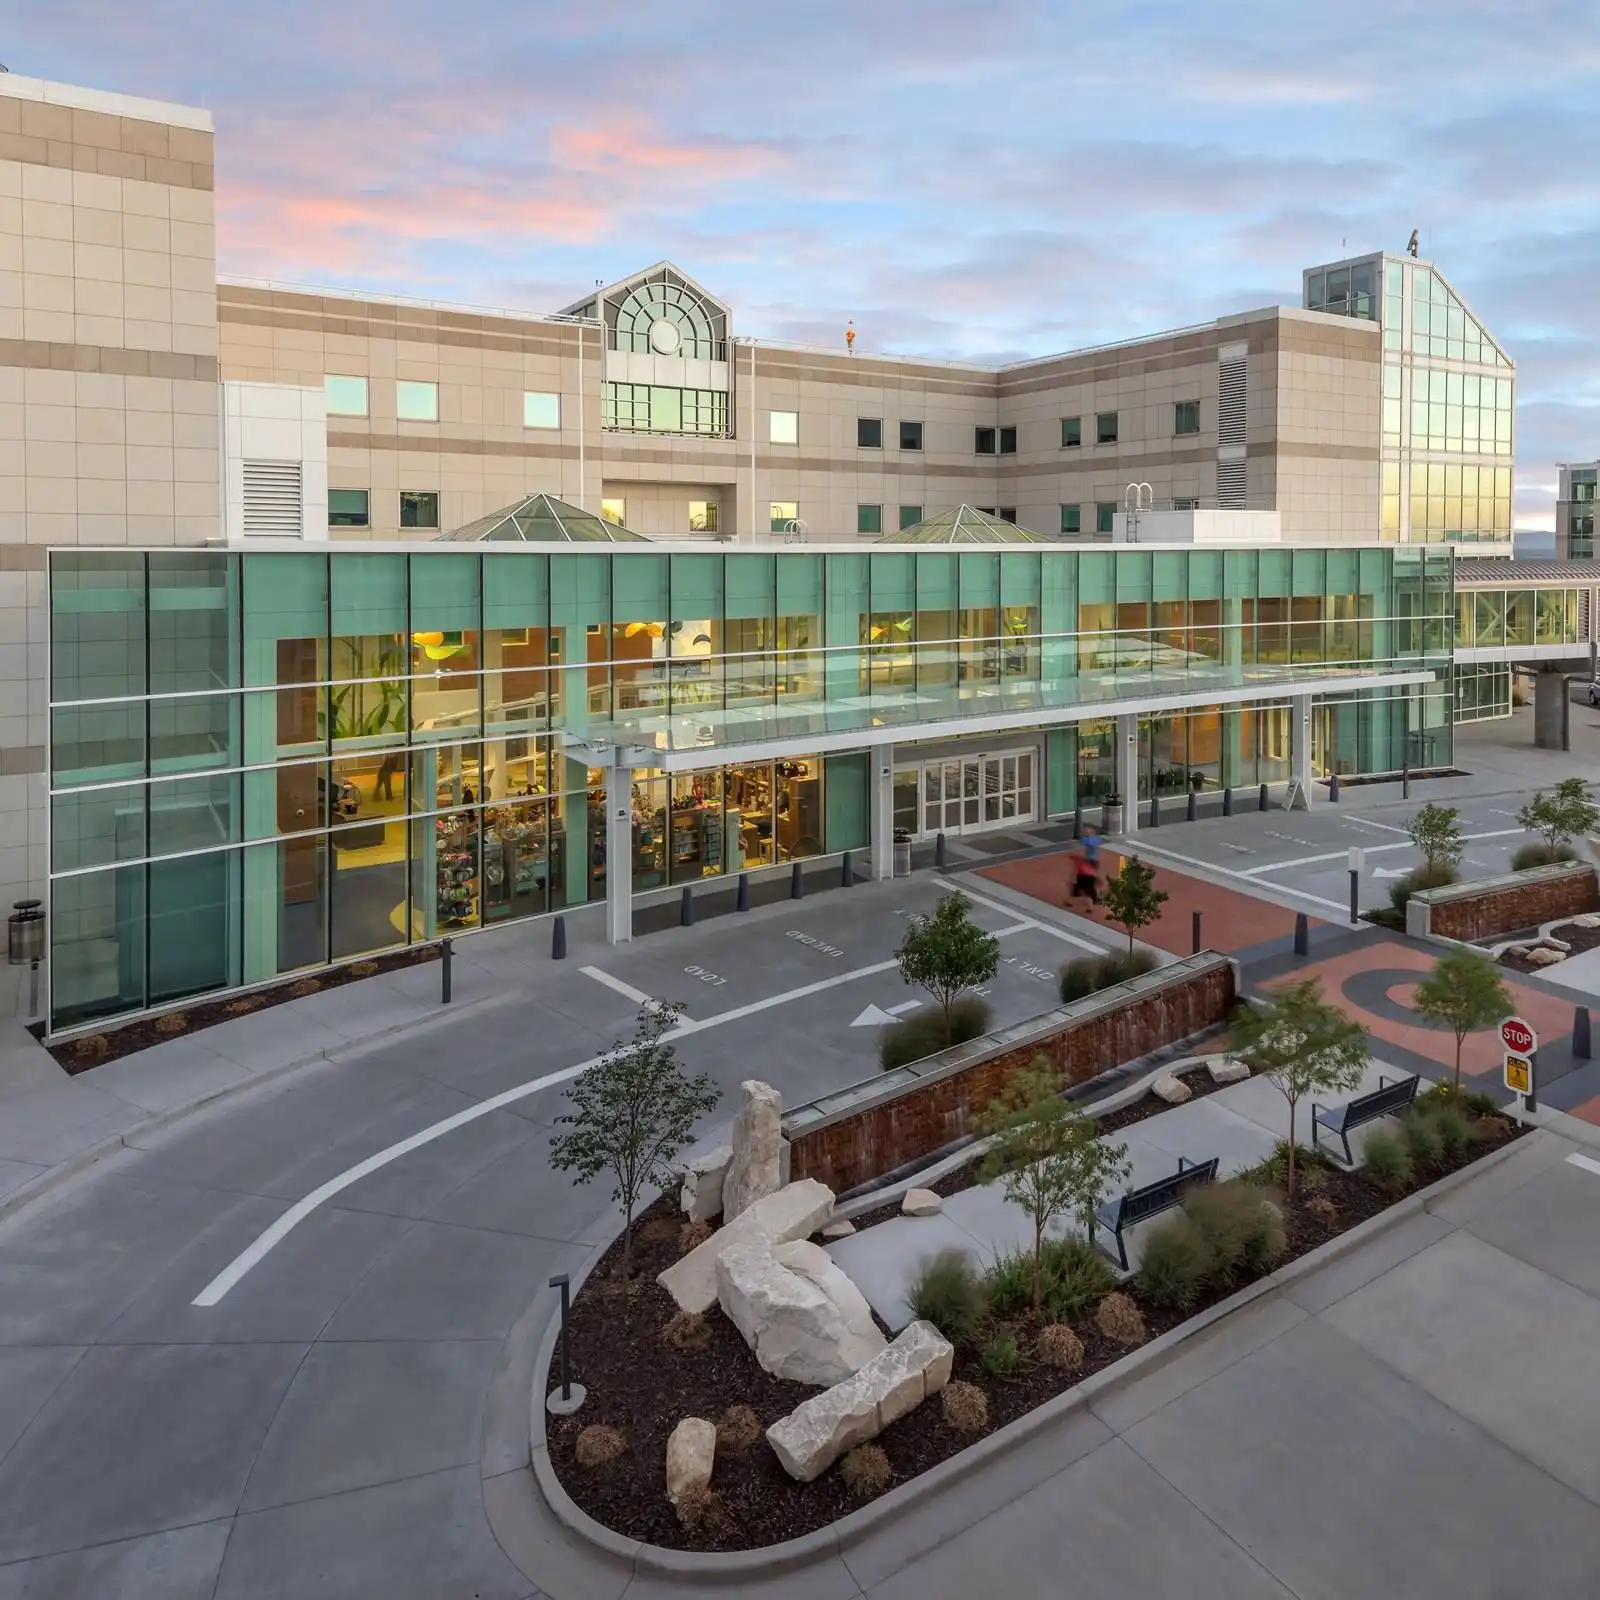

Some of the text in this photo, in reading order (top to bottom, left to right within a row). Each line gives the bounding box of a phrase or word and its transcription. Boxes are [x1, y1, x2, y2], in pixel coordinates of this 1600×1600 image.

[785, 930, 844, 957] UNLOAD
[684, 965, 728, 986] LOAD
[1003, 957, 1055, 980] ONLY
[1503, 1027, 1531, 1045] STOP
